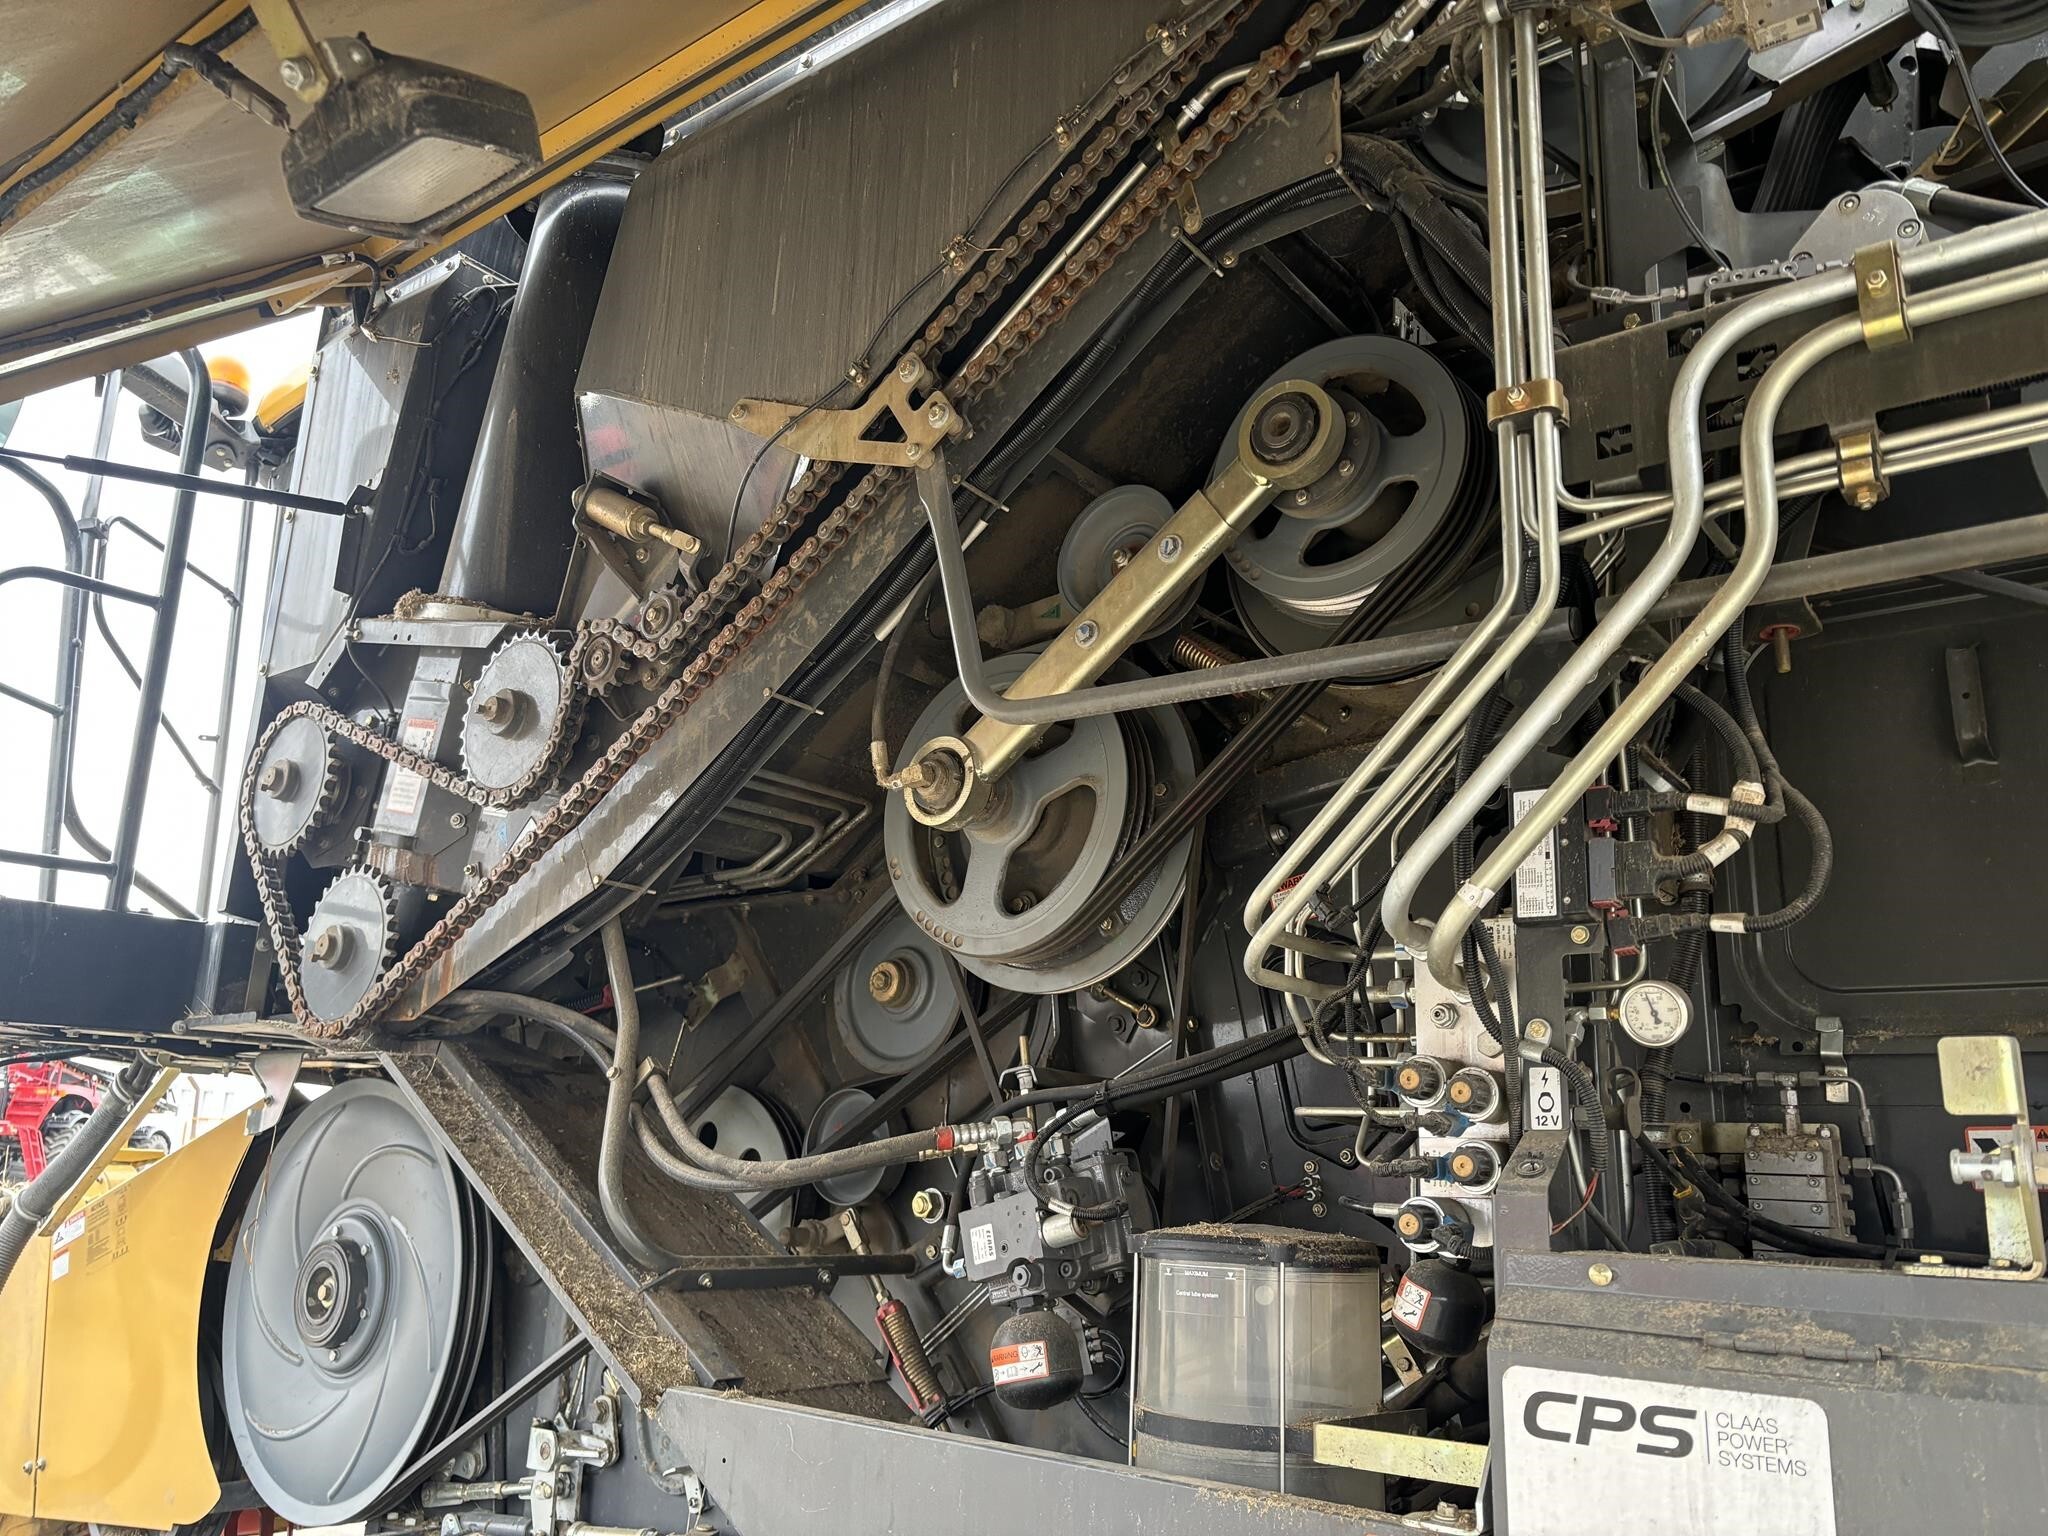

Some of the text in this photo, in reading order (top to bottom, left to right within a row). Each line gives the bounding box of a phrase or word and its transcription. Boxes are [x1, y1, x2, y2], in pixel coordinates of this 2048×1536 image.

[1535, 1115, 1559, 1127] 12 V
[1523, 1390, 1698, 1459] CPS
[1716, 1412, 1778, 1434] CLAAS
[1717, 1431, 1789, 1455] POWER
[1718, 1450, 1807, 1477] SYSTEMS
